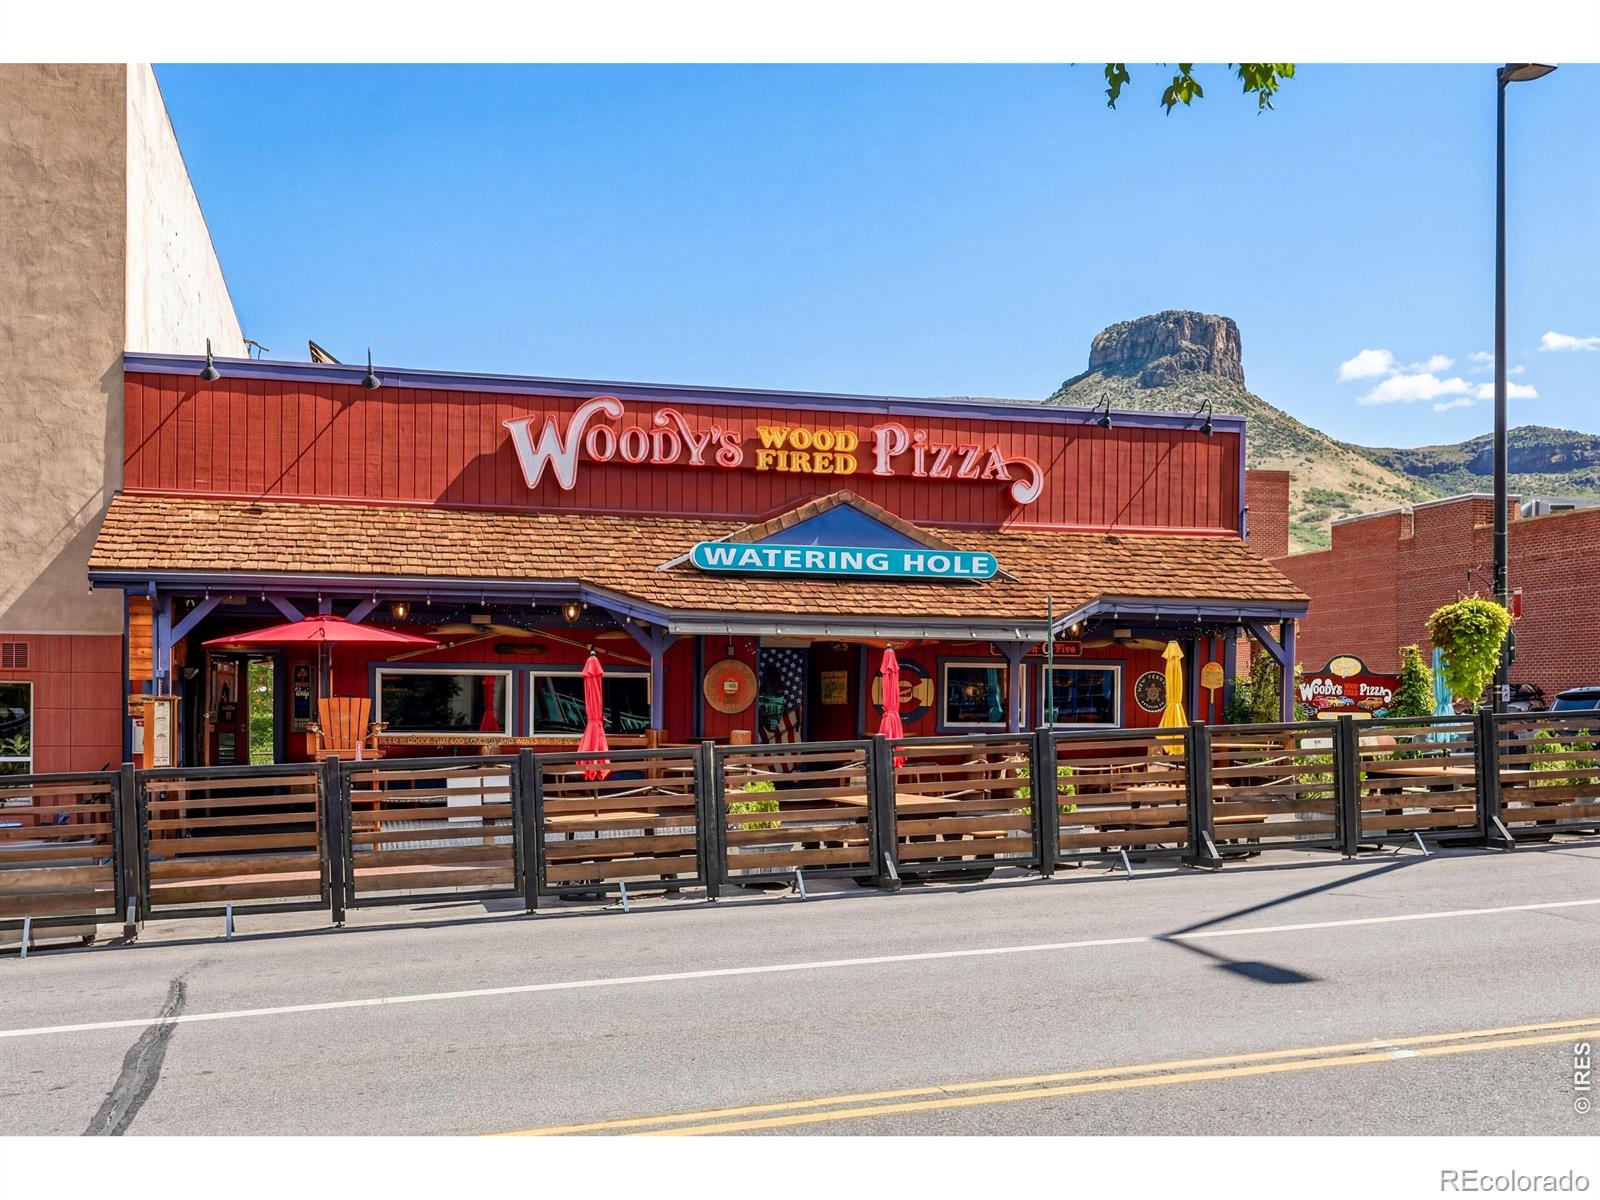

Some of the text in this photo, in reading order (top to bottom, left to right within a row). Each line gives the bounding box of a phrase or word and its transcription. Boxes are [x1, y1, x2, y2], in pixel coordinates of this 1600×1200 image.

[502, 396, 744, 491] WOODY'S
[756, 426, 859, 452] WOOD
[756, 449, 858, 475] FIRED
[703, 547, 990, 575] WATERING HOLE
